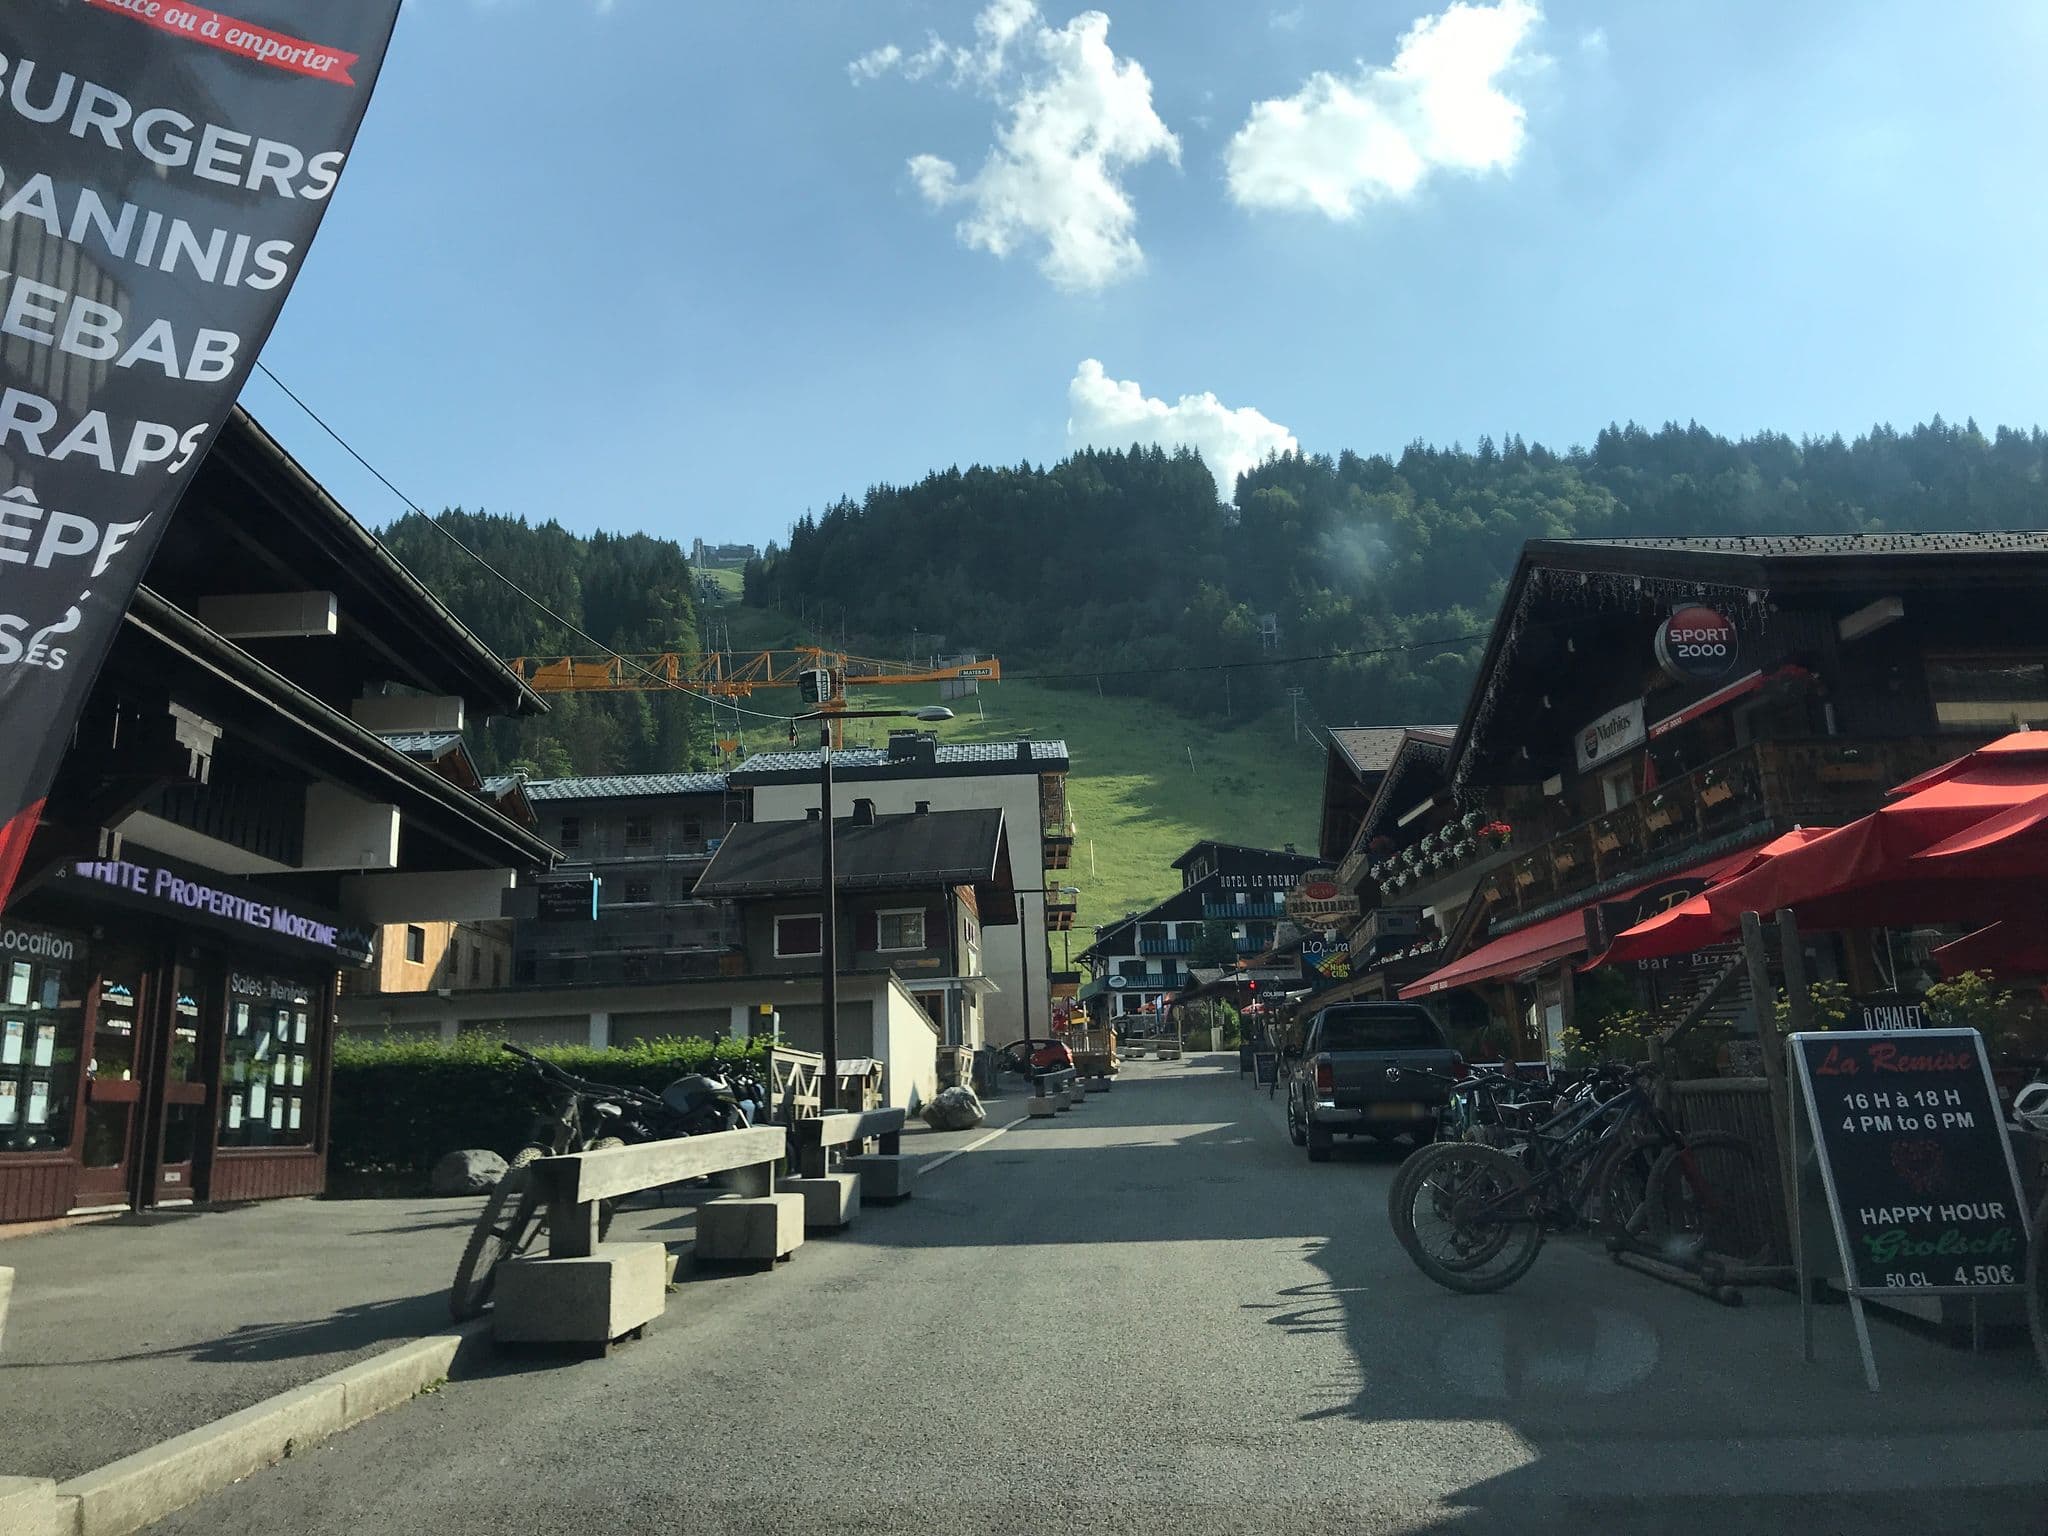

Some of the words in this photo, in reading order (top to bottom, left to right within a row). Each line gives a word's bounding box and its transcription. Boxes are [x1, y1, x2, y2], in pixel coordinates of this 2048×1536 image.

[84, 0, 161, 17] ace
[164, 8, 195, 31] ou
[201, 15, 221, 38] à
[225, 27, 339, 71] emporter
[0, 166, 295, 290] ANINIS
[0, 269, 240, 382] EBAB
[1670, 627, 1729, 642] SPORT
[1678, 643, 1726, 657] 2000
[1596, 712, 1631, 742] Mathias
[1220, 875, 1247, 887] HOTEL
[1252, 875, 1263, 887] LE
[76, 861, 149, 894] WHITE
[154, 868, 271, 929] PROPERTIES
[272, 906, 339, 949] MORZINE
[0, 929, 73, 960] ocation
[1331, 970, 1349, 978] Club
[1638, 957, 1670, 970] Bar
[231, 972, 263, 997] Sales
[1873, 1005, 1923, 1030] CHALET
[1816, 1046, 1860, 1075] La
[1868, 1042, 1975, 1074] Remise
[1843, 1093, 1869, 1110] 16
[1874, 1092, 1890, 1109] H
[1896, 1091, 1909, 1108] à
[1914, 1090, 1939, 1106] 18
[1945, 1089, 1961, 1105] H
[1842, 1117, 1856, 1133] 4
[1862, 1115, 1892, 1132] PM
[1899, 1114, 1919, 1131] to
[1924, 1113, 1936, 1130] 6
[1943, 1112, 1975, 1129] PM
[1860, 1205, 1933, 1225] HAPPY
[1940, 1202, 2006, 1222] HOUR
[1862, 1227, 2017, 1263] Grolsch
[1886, 1273, 1905, 1288] 50
[1910, 1271, 1933, 1288] CL
[1954, 1265, 2016, 1285] 4.50€
